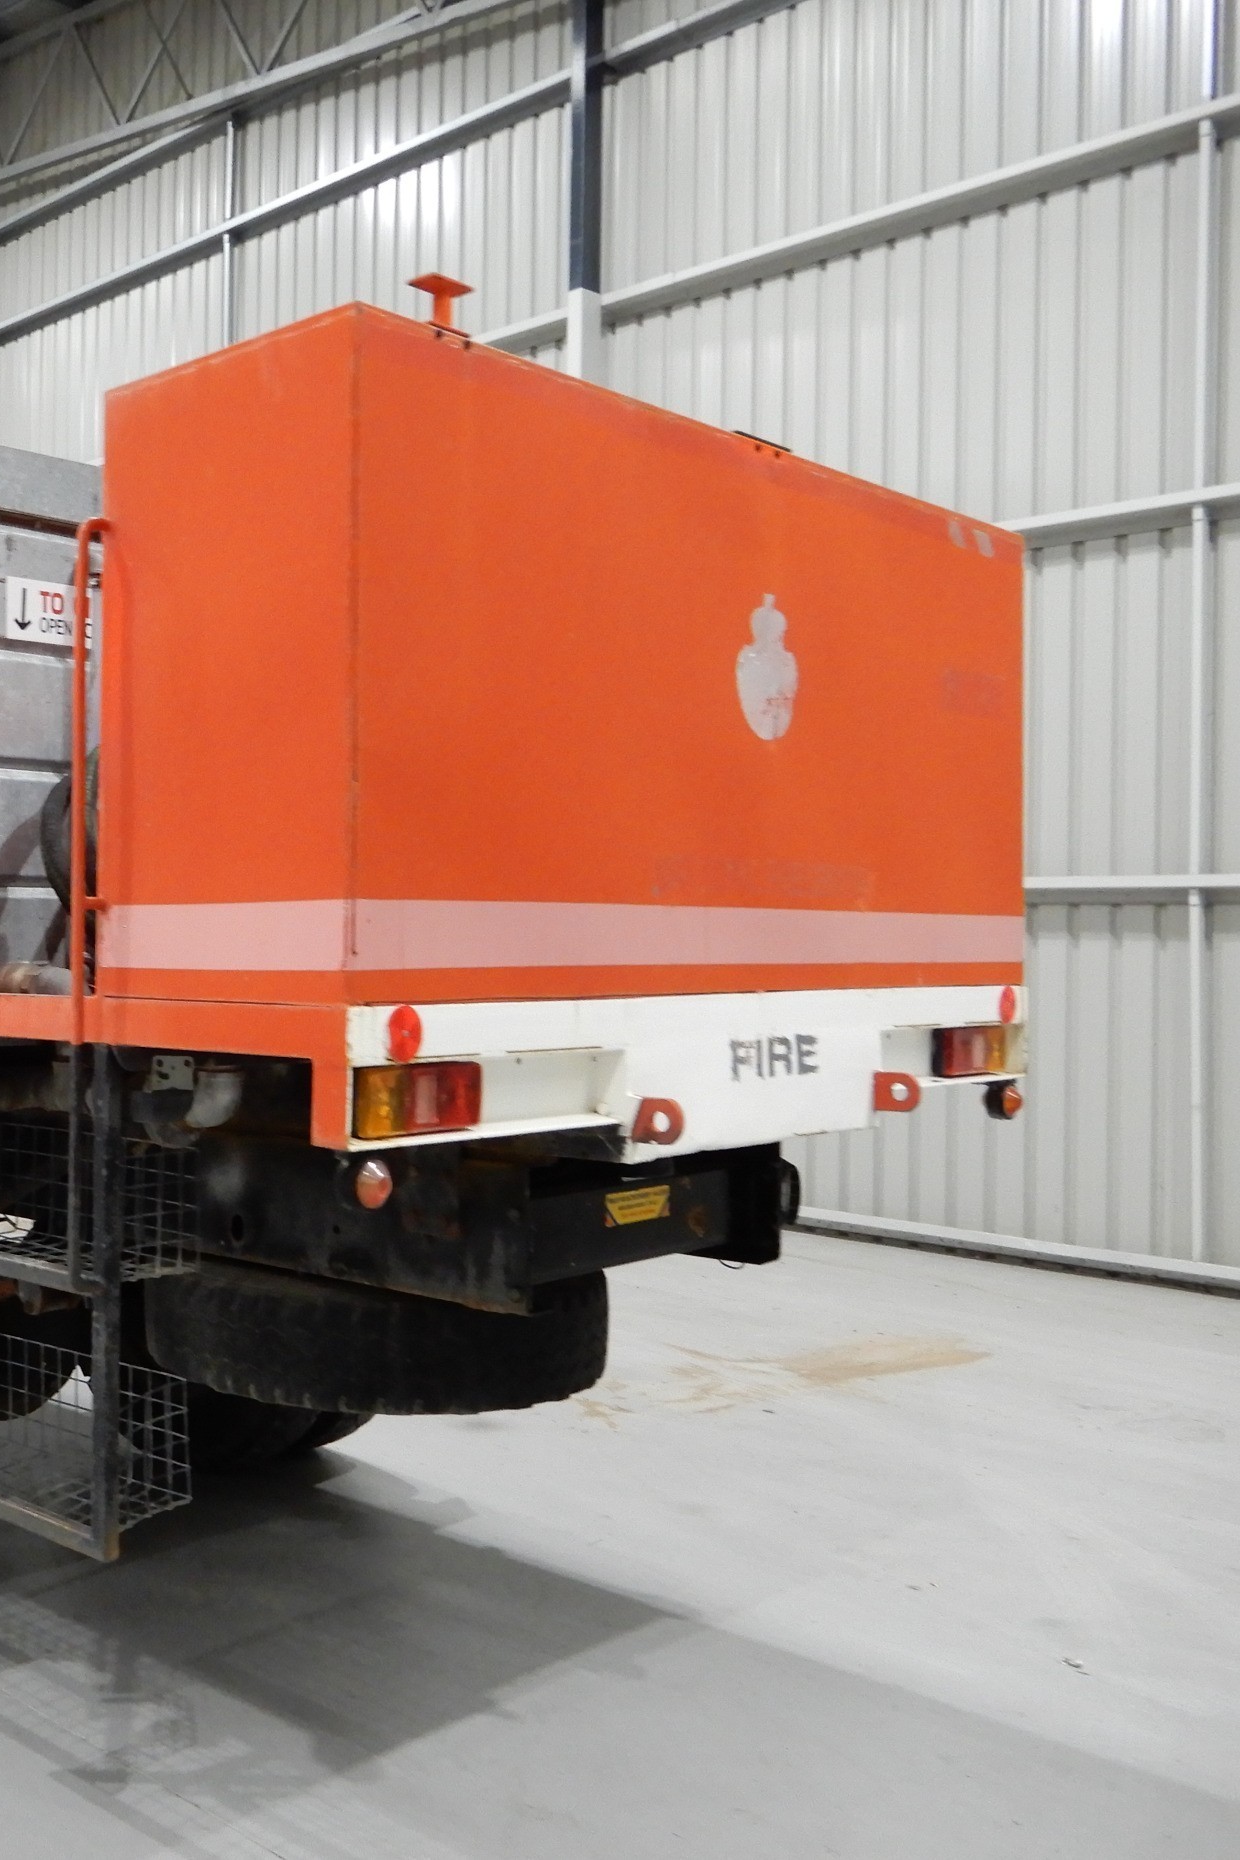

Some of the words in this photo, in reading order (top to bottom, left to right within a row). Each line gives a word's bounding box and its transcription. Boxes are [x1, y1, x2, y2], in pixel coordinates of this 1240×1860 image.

[39, 591, 65, 614] TO
[39, 616, 72, 637] OPEN
[729, 1033, 818, 1081] FIRE
